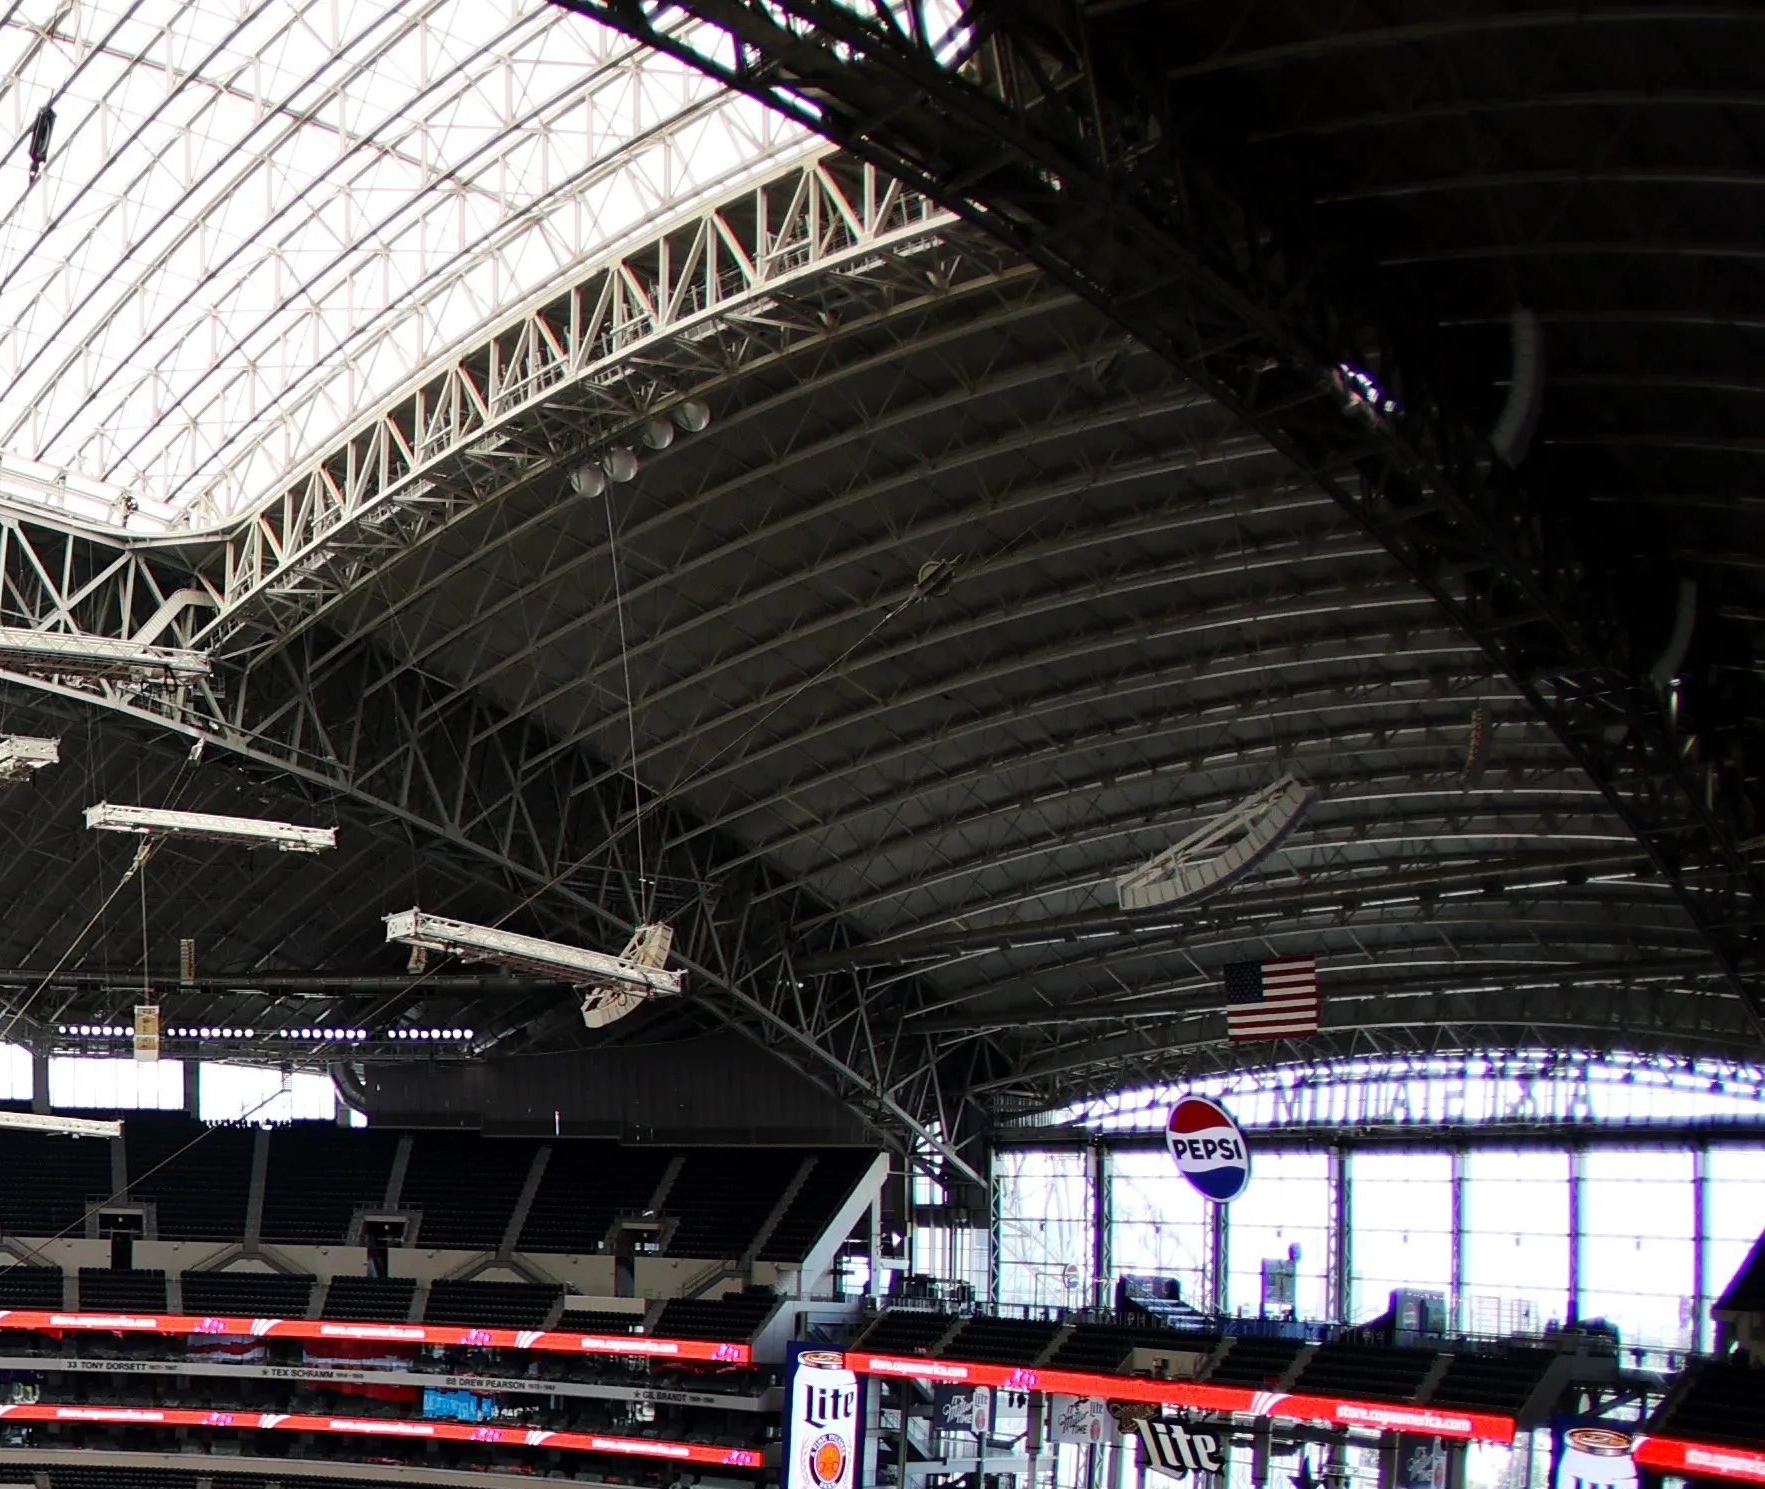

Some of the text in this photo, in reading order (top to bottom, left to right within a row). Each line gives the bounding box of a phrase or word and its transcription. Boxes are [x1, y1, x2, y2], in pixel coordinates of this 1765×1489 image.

[1172, 1138, 1243, 1160] PEPSI
[51, 1315, 156, 1327] store.copaamerica.com
[321, 1325, 424, 1338] store.copaamerica.com
[582, 1338, 677, 1353] store.copaamerica.com
[67, 1360, 146, 1371] 33 TONY DORSETT
[869, 1359, 967, 1380] store.copaamerica.com
[271, 1368, 334, 1380] TEX SCHRAMM
[459, 1378, 526, 1390] DREW PEARSON
[642, 1391, 657, 1400] GIL
[975, 1391, 988, 1408] Lite
[803, 1384, 854, 1429] Lite
[1089, 1401, 1103, 1418] Lite
[57, 1409, 163, 1420] store.copaamerica.com
[956, 1415, 972, 1424] TIME
[1336, 1406, 1471, 1434] store.copaamerica.com
[330, 1421, 433, 1434] store.copaamerica.com
[1072, 1425, 1088, 1435] TIME
[592, 1439, 688, 1456] store.copaamerica.com
[1132, 1418, 1222, 1481] Lite
